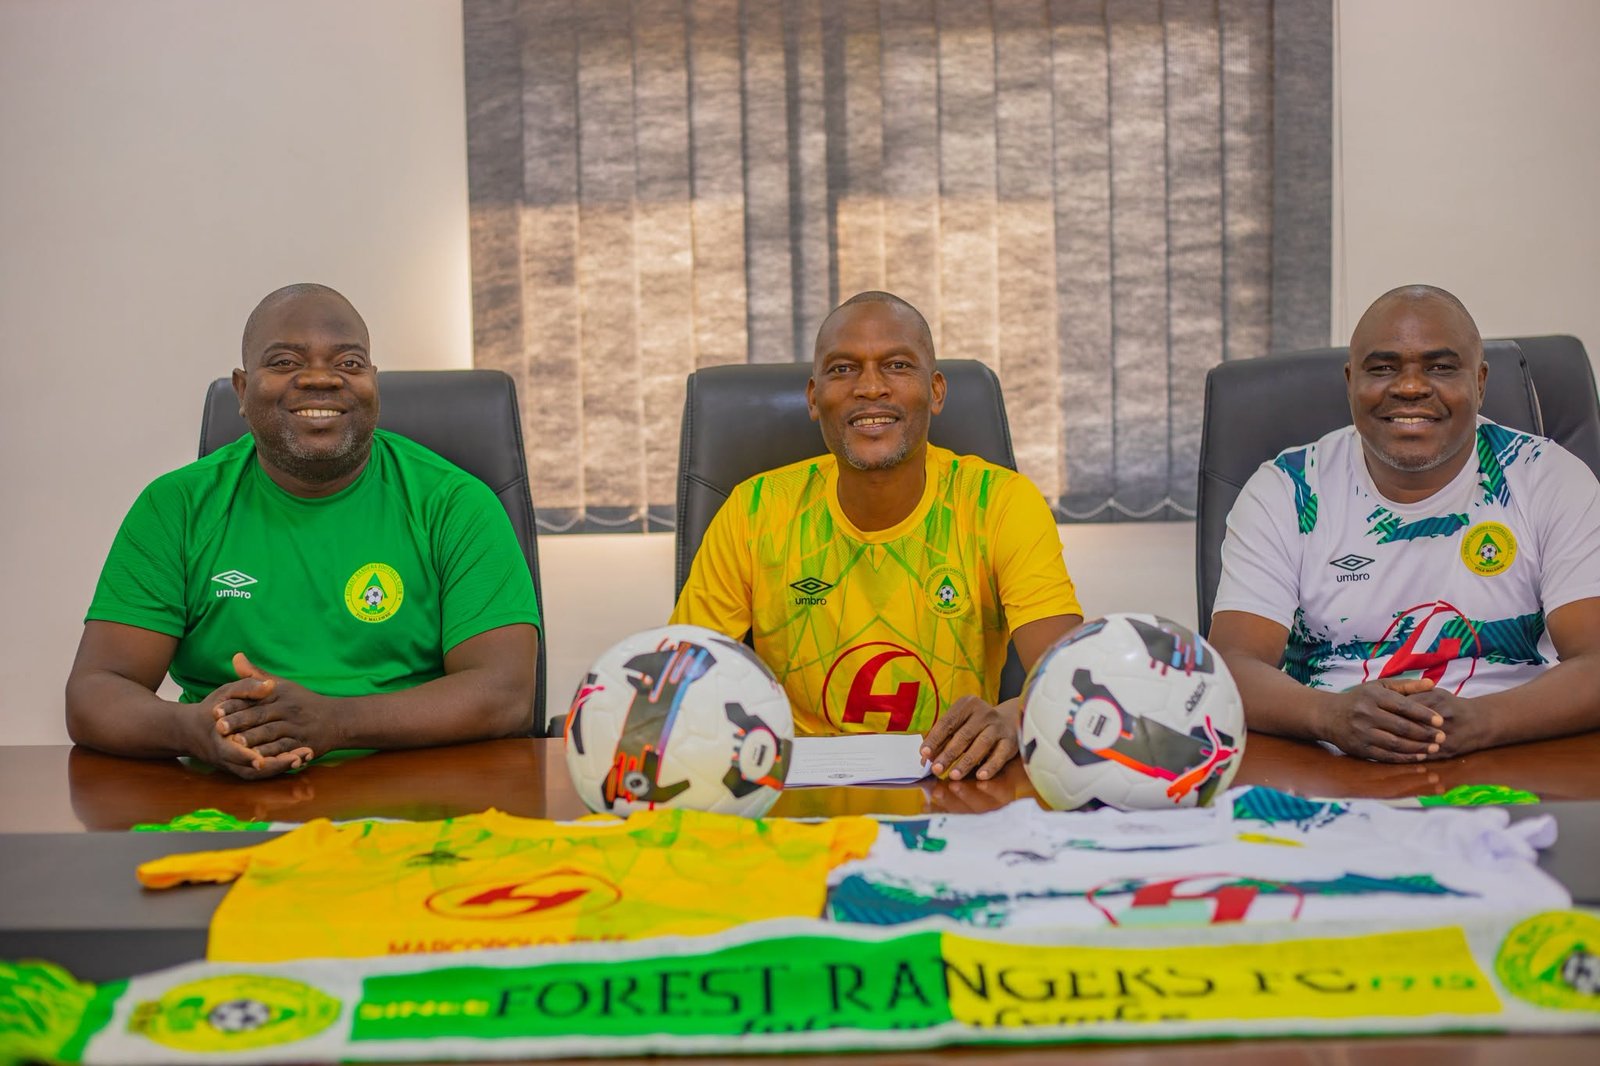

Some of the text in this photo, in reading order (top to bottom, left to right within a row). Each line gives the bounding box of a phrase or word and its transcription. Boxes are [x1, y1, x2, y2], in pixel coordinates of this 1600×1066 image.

[1336, 572, 1370, 583] umbro
[216, 589, 251, 599] umbro
[795, 596, 827, 606] umbro
[495, 963, 791, 1018] FOREST
[823, 957, 1216, 1013] RANGERS
[1253, 969, 1358, 995] FC
